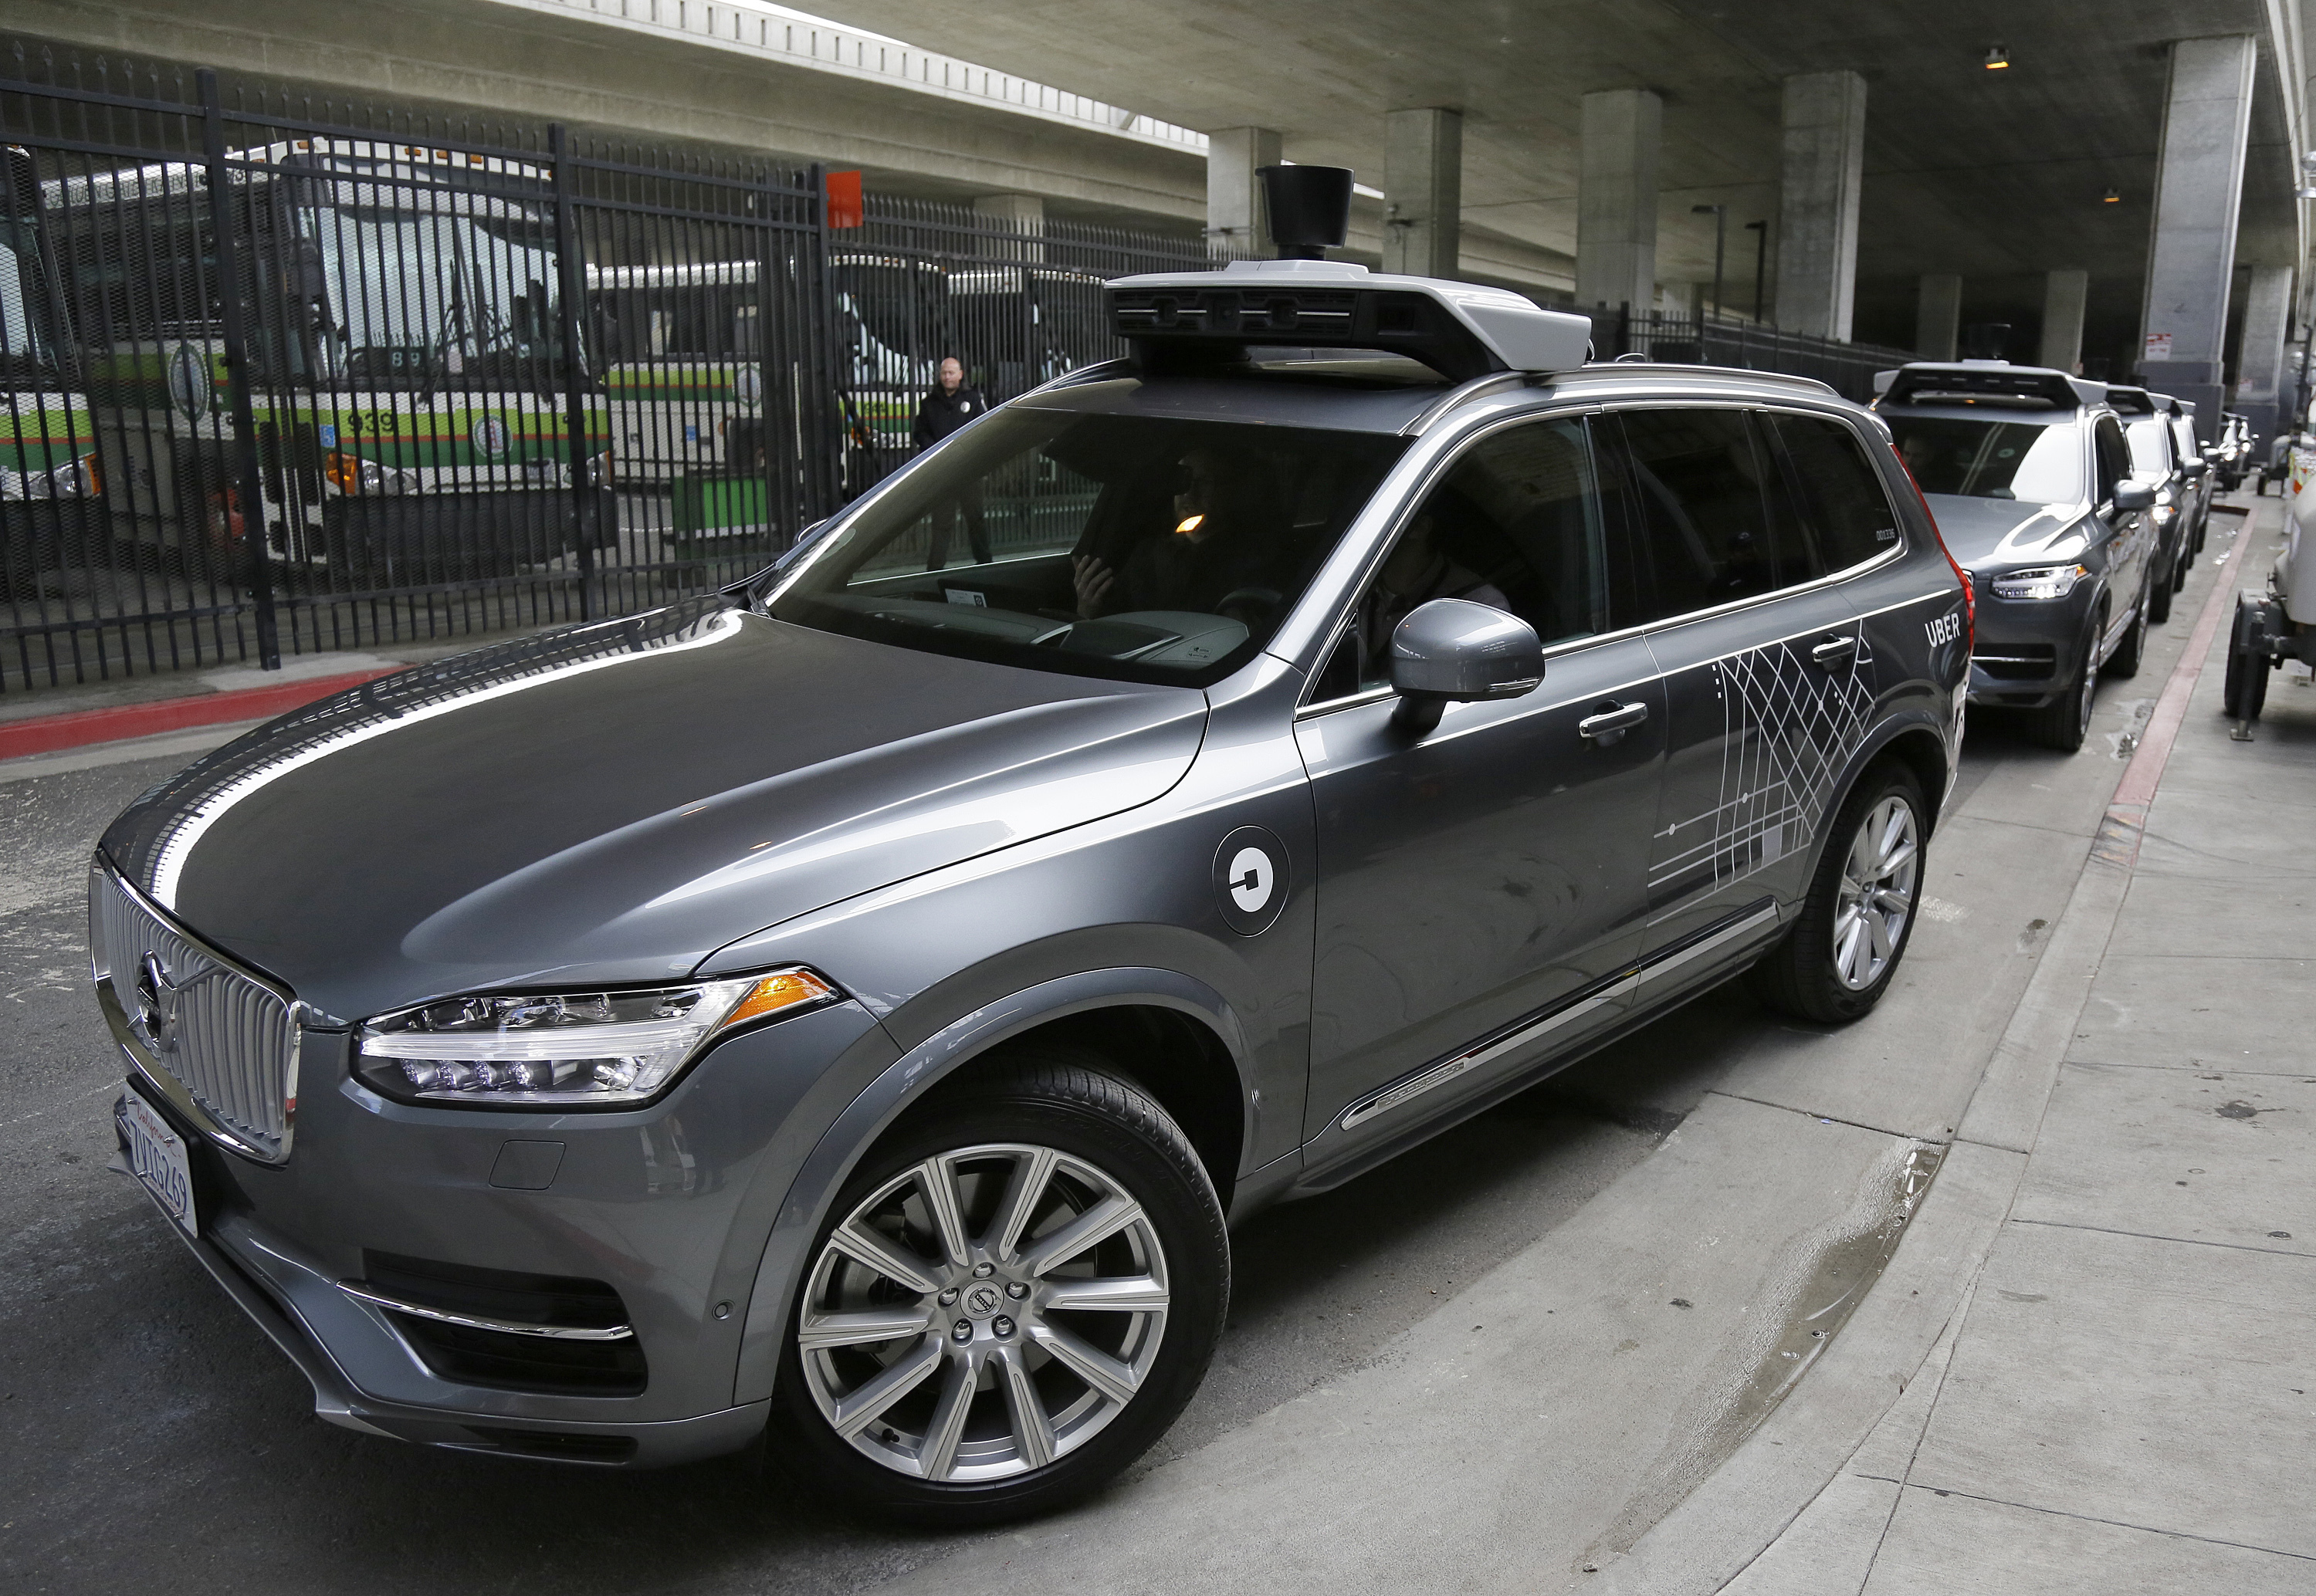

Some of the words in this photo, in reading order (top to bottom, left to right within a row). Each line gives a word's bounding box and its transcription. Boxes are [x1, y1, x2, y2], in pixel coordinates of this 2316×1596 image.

[348, 412, 394, 432] 939
[1925, 613, 1960, 648] UBER
[130, 1119, 188, 1215] 7VIG269
[976, 1295, 990, 1310] VOLVO
